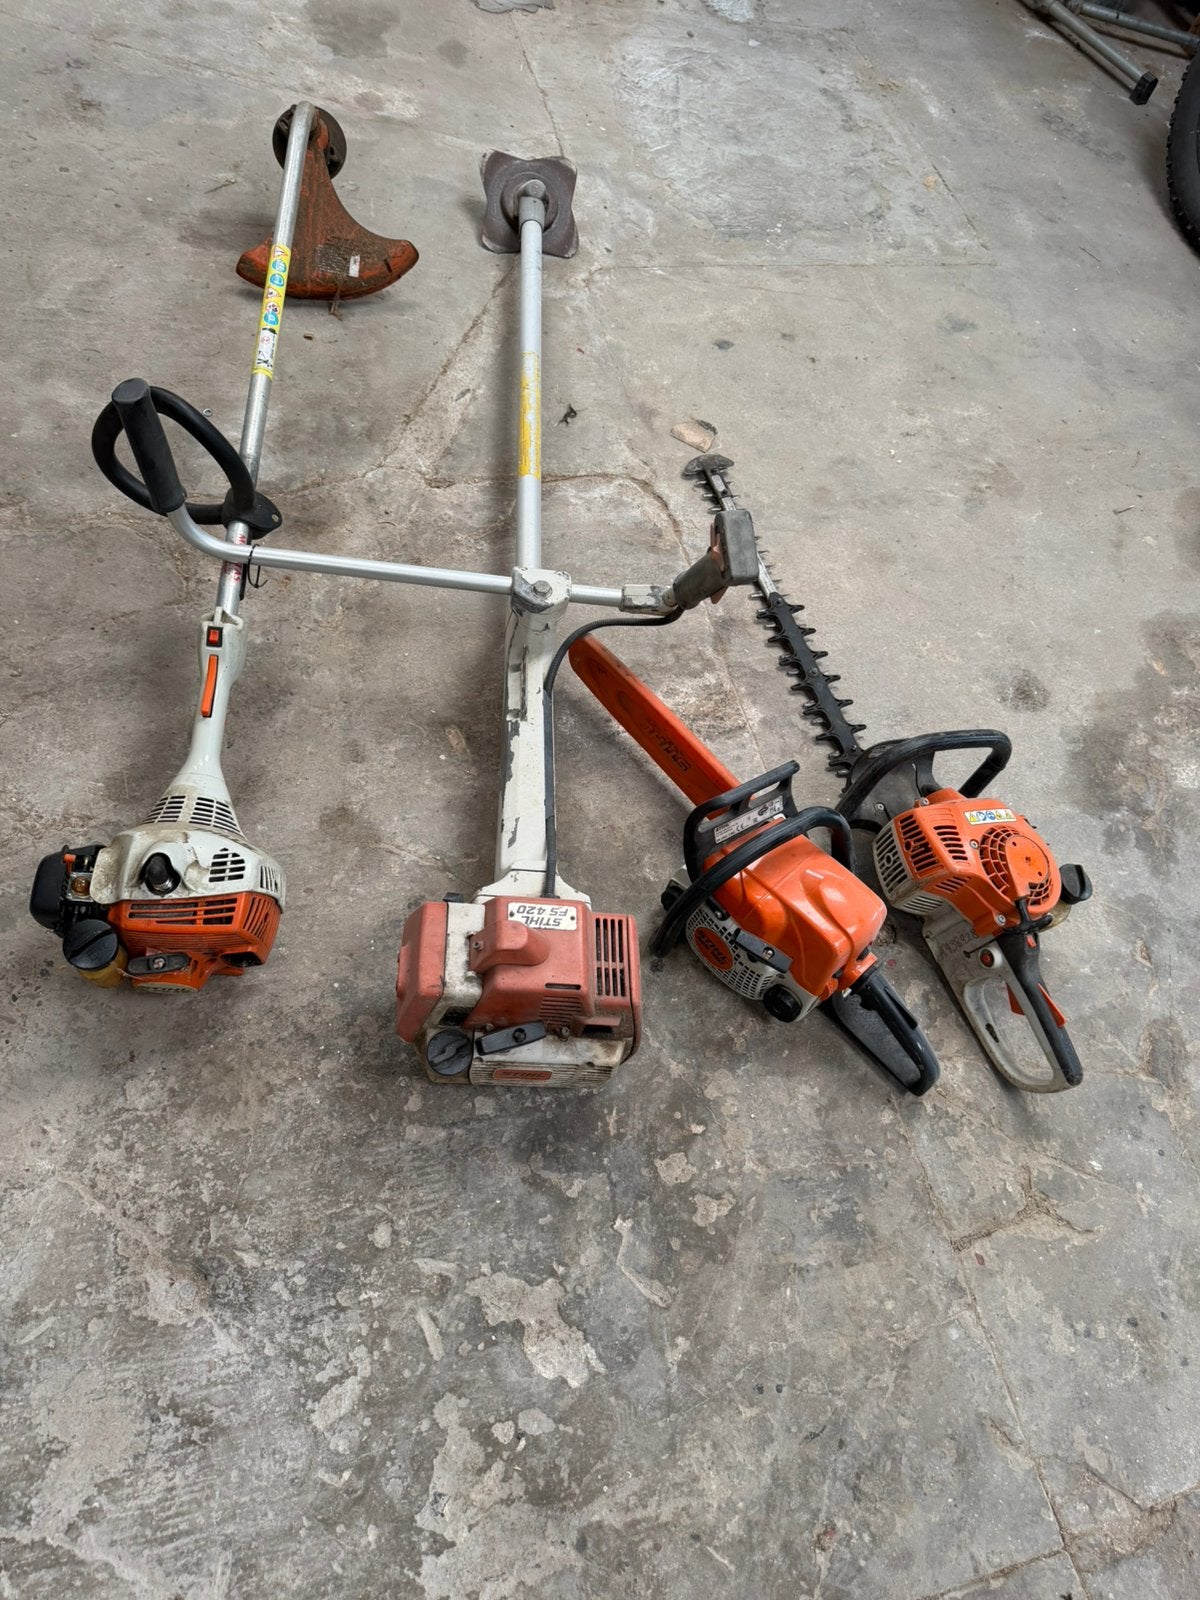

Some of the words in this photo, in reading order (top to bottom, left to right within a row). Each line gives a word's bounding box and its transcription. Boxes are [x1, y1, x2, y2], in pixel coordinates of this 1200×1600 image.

[517, 905, 546, 915] 420
[549, 907, 568, 917] FS
[521, 915, 562, 927] STIHL
